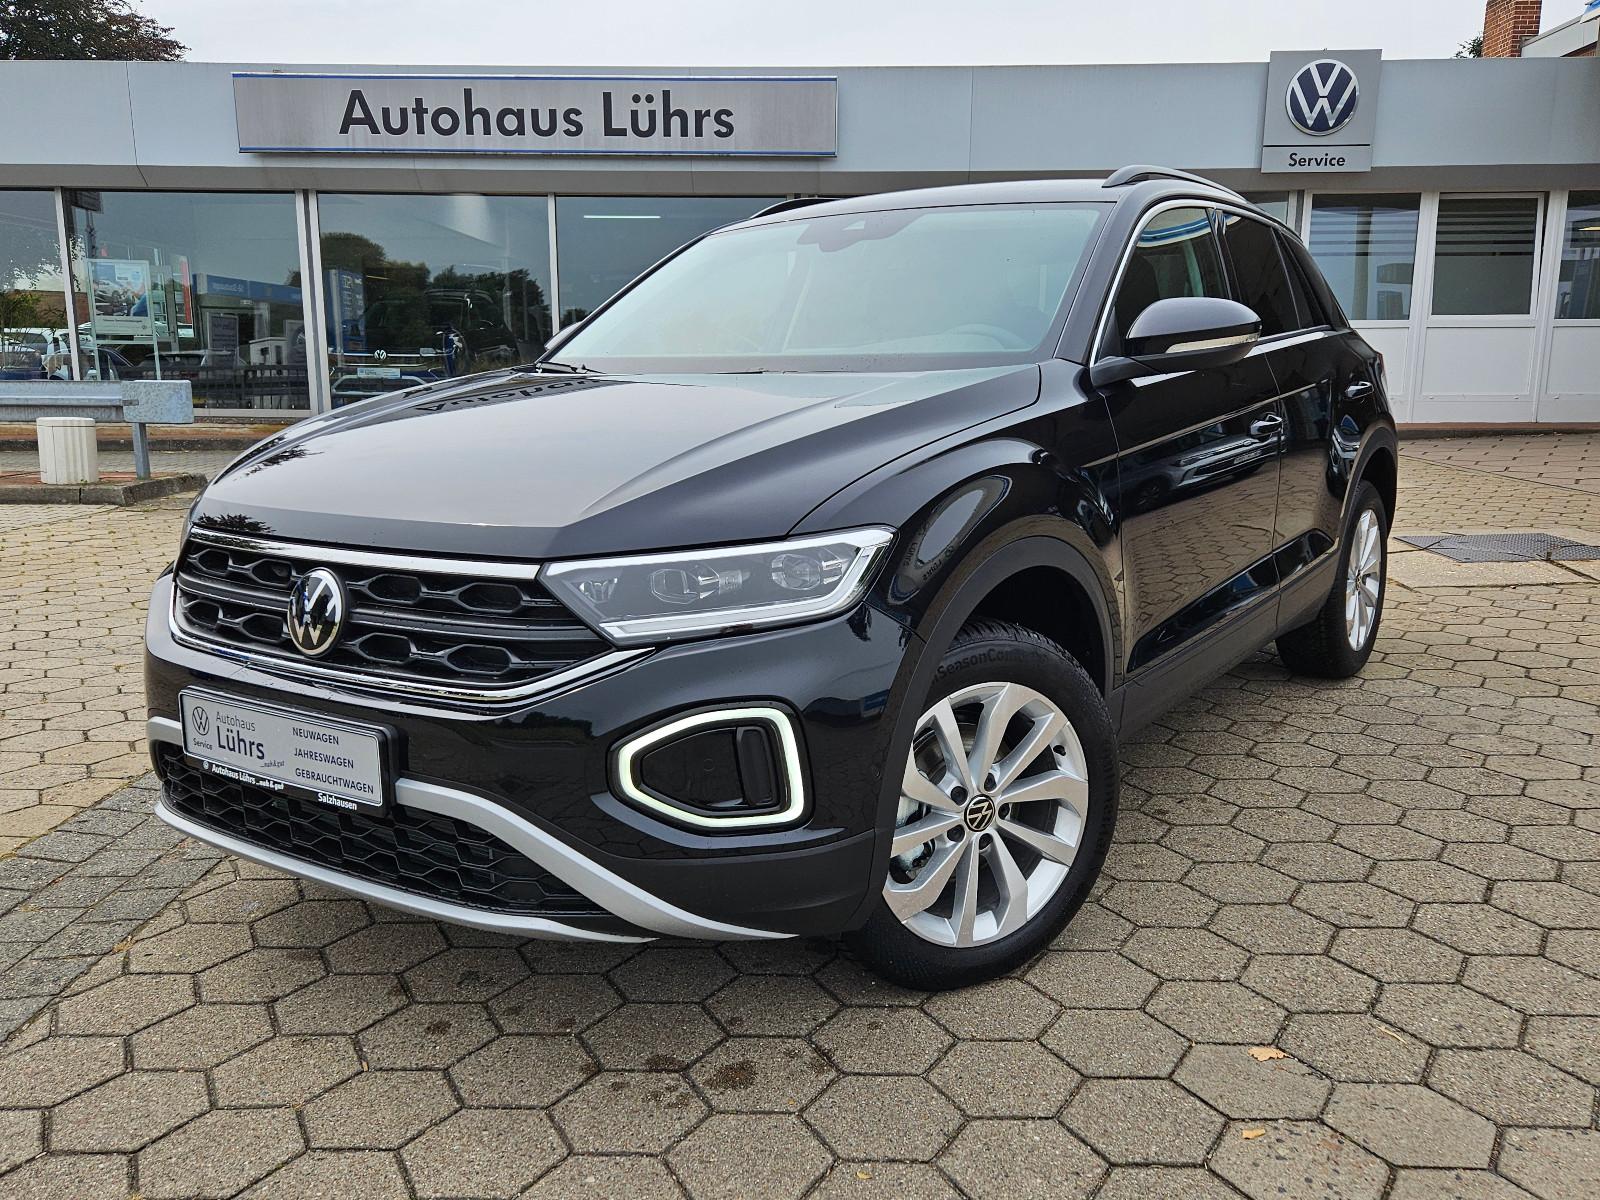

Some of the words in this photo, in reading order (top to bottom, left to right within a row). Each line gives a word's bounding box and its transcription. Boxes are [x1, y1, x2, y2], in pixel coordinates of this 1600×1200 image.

[338, 88, 584, 138] Autohaus
[602, 89, 735, 139] Lührs
[1288, 152, 1346, 167] Service
[215, 711, 256, 731] Autohaus
[193, 737, 213, 751] Service
[216, 725, 265, 760] Lührs
[292, 726, 340, 745] NEUWAGEN
[294, 747, 354, 769] JAHRESWAGEN
[211, 764, 239, 780] Autohaus
[239, 771, 256, 785] Lührs
[295, 767, 374, 795] GEBRAUCHTWAGEN
[318, 792, 357, 811] Salzhausen
